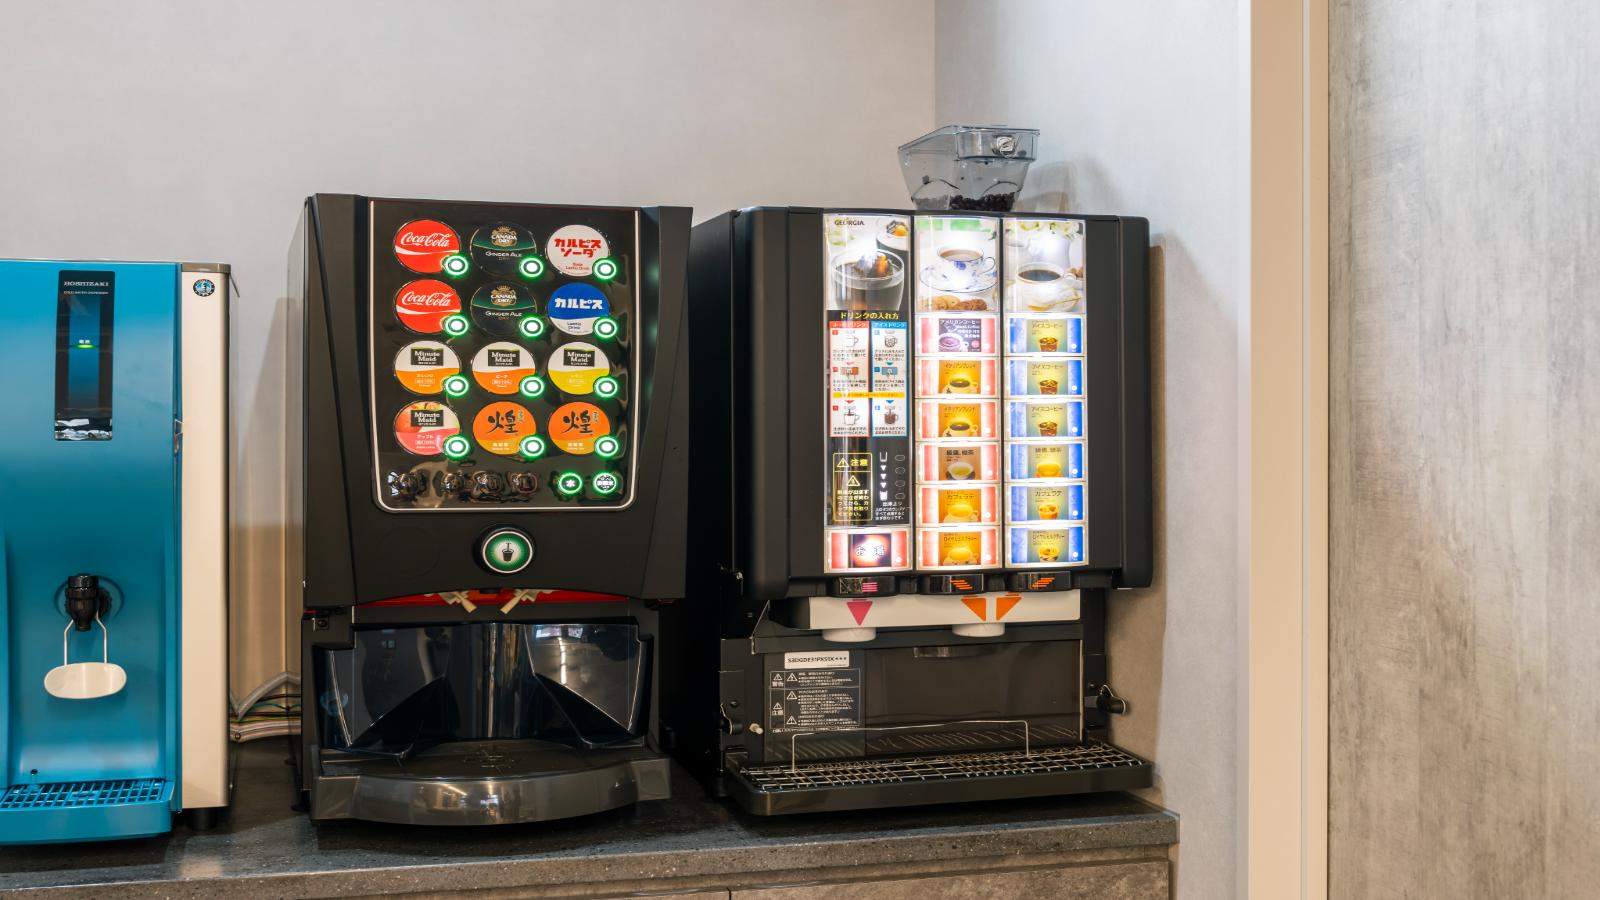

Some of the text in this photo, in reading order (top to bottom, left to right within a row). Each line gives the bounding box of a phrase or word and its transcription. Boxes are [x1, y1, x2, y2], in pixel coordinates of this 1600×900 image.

[400, 231, 452, 248] Coca-Cola
[554, 238, 602, 249] カルピス
[560, 248, 597, 258] ソーダ
[402, 291, 454, 307] Coca-Cola
[554, 297, 603, 310] カルピス
[840, 312, 899, 320] ドリンクの入れ方
[488, 409, 519, 433] 煌
[562, 409, 593, 433] 煌
